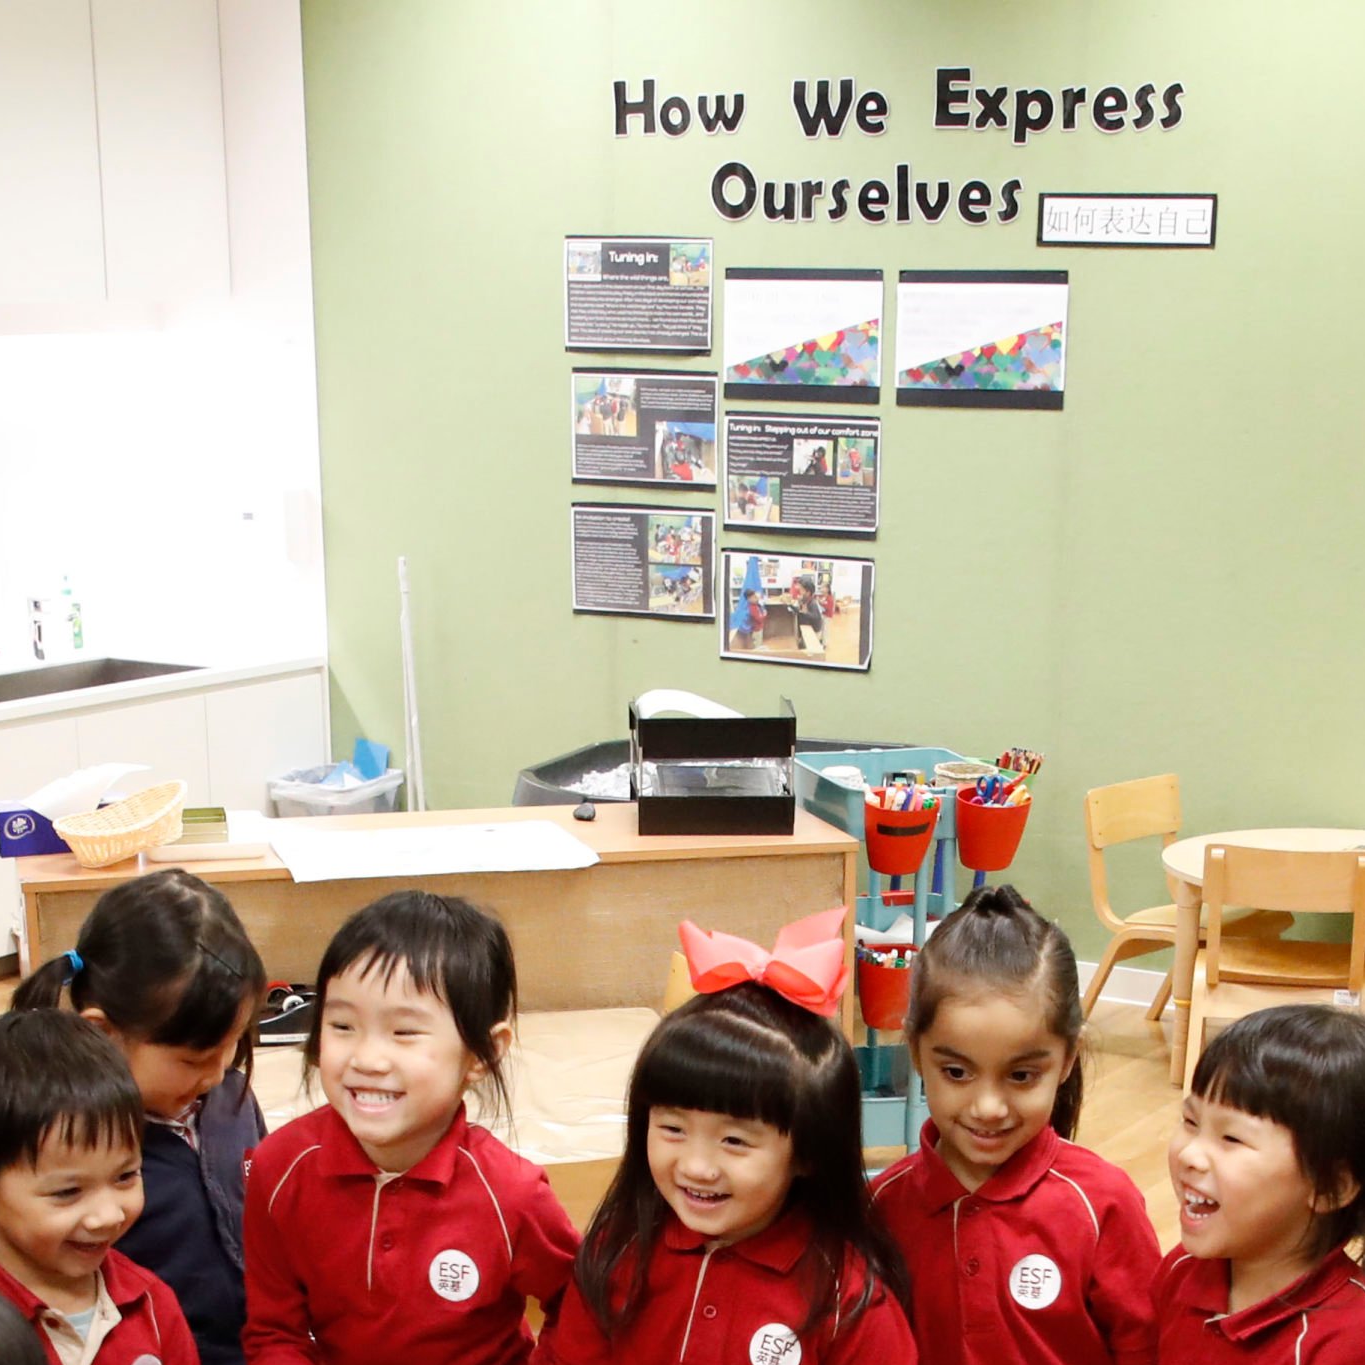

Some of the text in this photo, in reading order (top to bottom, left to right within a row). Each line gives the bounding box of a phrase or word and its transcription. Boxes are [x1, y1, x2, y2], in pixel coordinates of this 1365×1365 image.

[613, 67, 1186, 144] How We Express
[711, 161, 1022, 223] Ourselves
[1046, 206, 1208, 236] 如何表达自己
[608, 251, 645, 266] Tuning
[729, 423, 753, 434] Tuning
[439, 1262, 470, 1279] ESF
[1020, 1267, 1052, 1285] ESF
[761, 1334, 793, 1356] ESF
